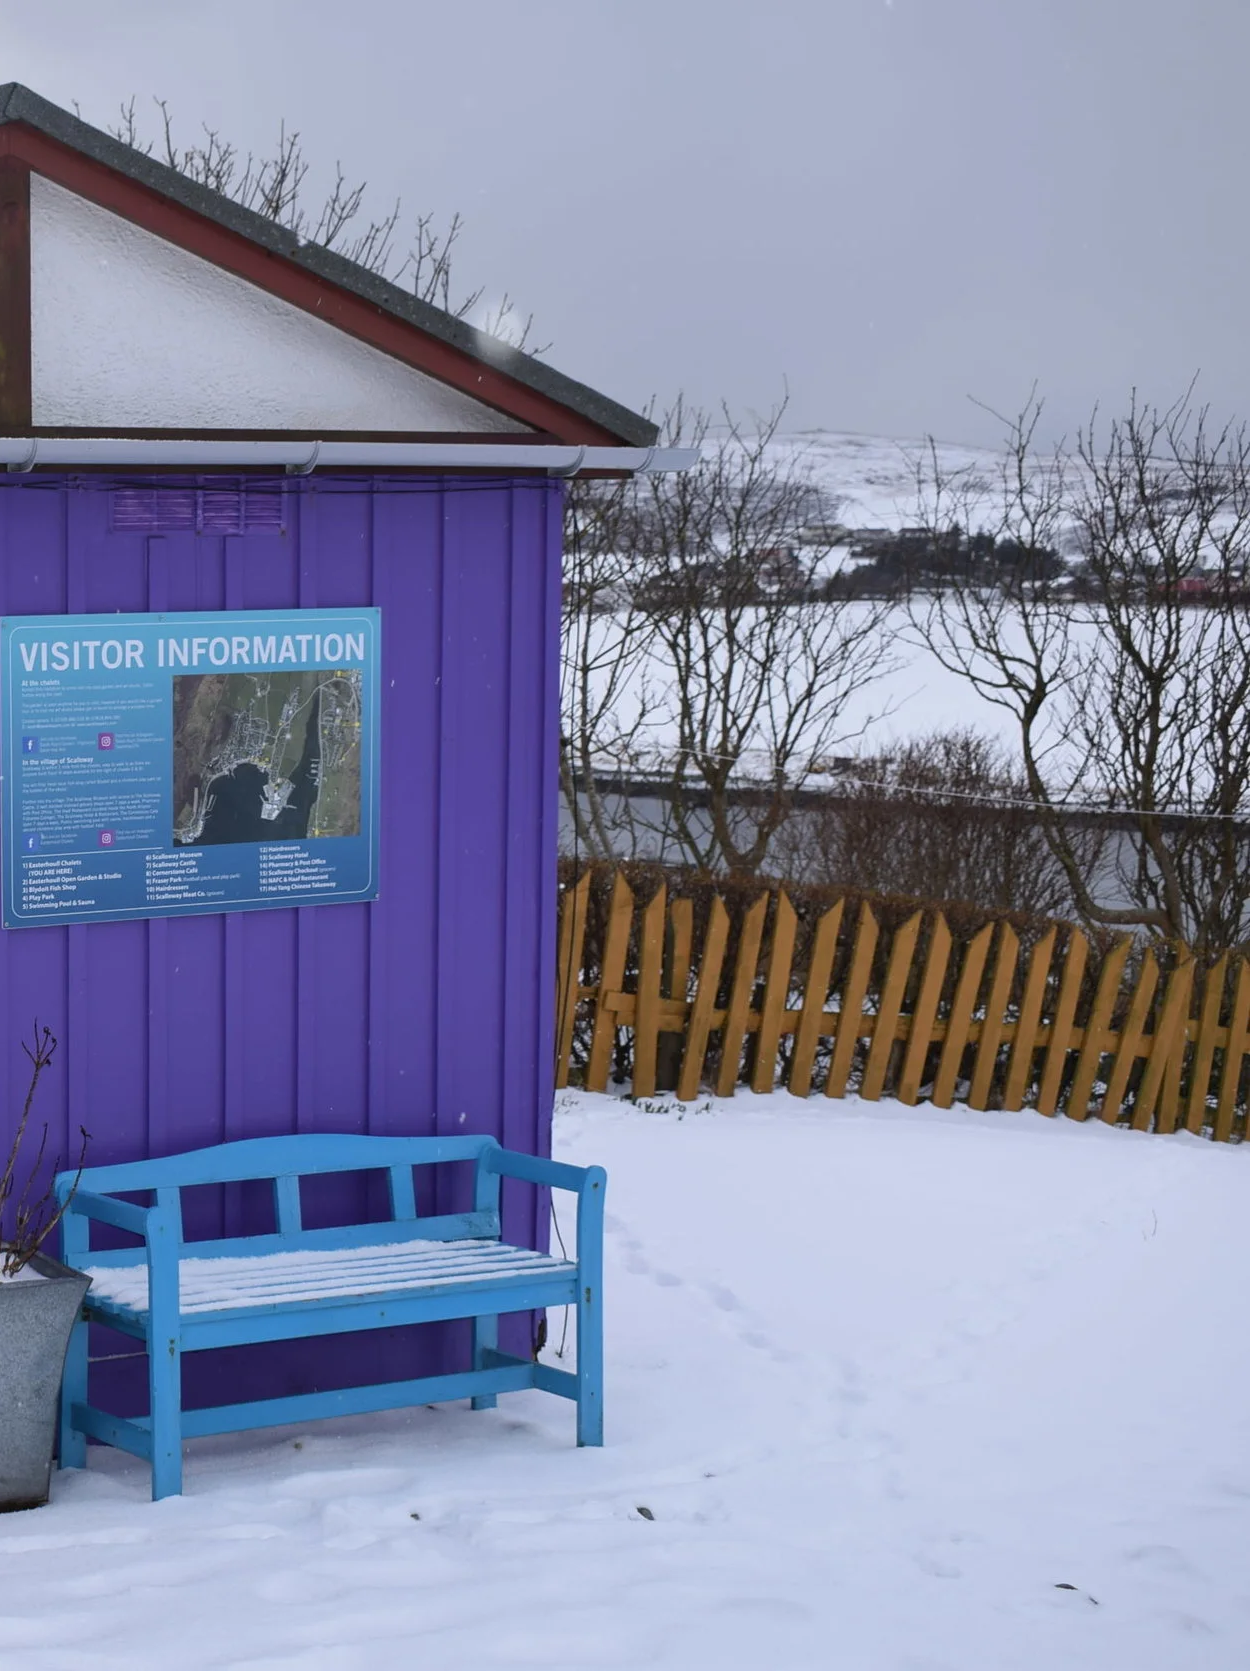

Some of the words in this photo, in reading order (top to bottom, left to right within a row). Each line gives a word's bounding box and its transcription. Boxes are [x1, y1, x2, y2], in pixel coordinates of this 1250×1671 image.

[19, 638, 144, 672] VISITOR
[158, 632, 365, 667] INFORMATION
[29, 869, 43, 877] (YOU
[62, 884, 76, 892] Shop
